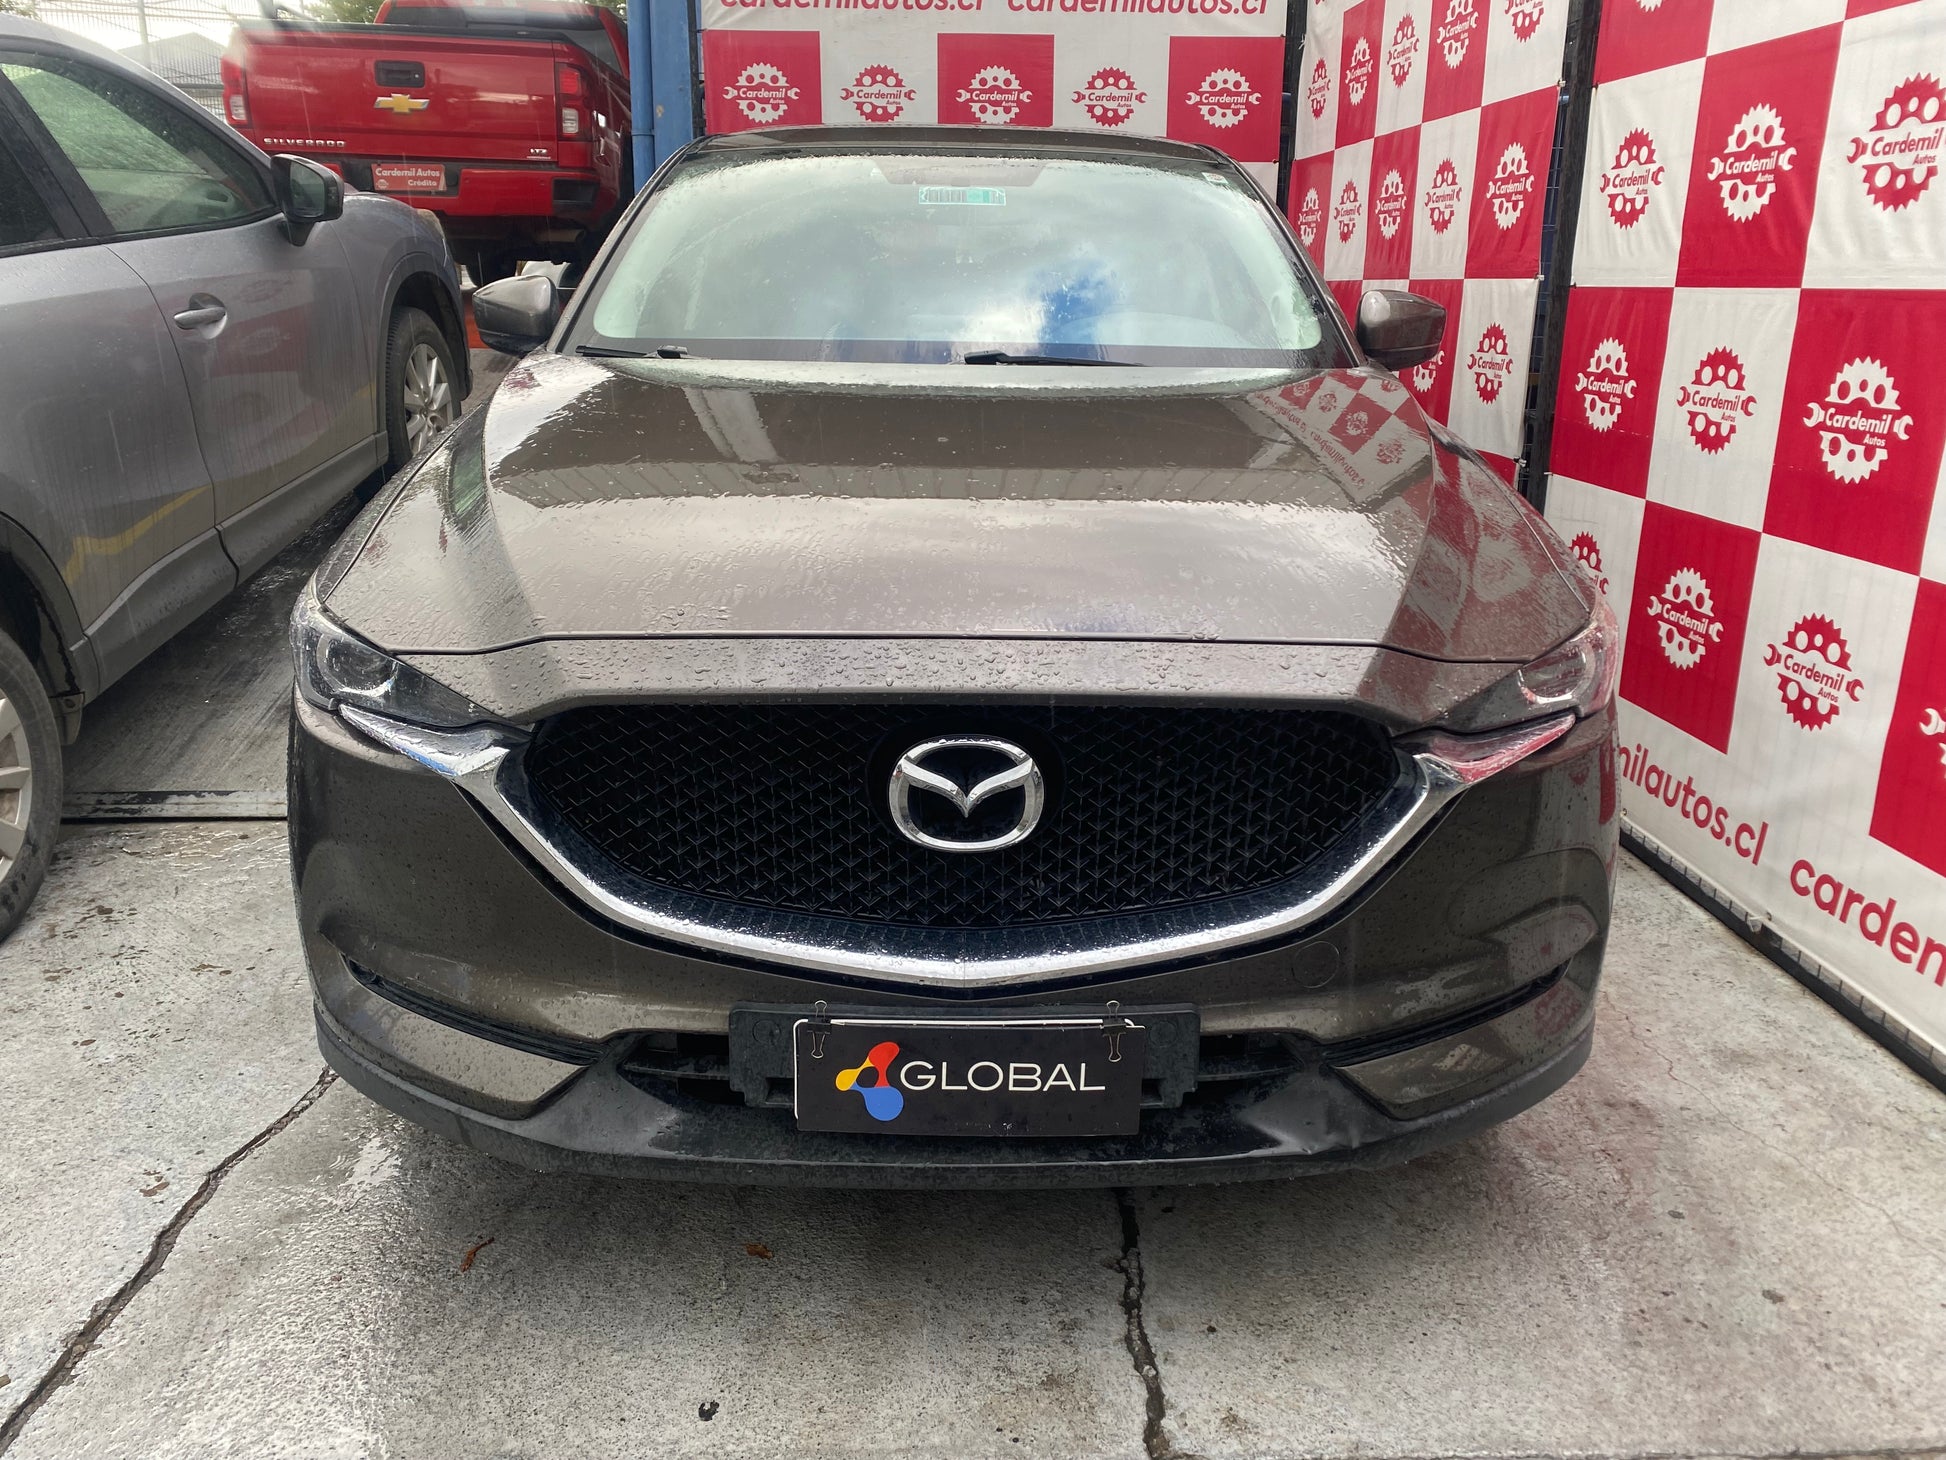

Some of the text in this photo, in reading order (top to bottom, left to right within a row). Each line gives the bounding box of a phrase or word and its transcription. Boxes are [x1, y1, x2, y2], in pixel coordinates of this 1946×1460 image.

[739, 88, 785, 98] Cardemil
[856, 89, 902, 99] Cardemil
[972, 91, 1018, 101] Cardemil
[1088, 92, 1133, 102] Cardemil
[1202, 93, 1247, 103] Cardemil
[263, 137, 346, 148] SILVERADO
[1871, 127, 1945, 156] Cardemil
[1726, 150, 1779, 175] Cardemil
[1912, 153, 1937, 165] Autos
[1611, 168, 1651, 188] Cardemil
[1588, 375, 1625, 394] Cardemil
[1691, 390, 1741, 412] Cardemil
[1825, 407, 1893, 434] Cardemil
[1863, 433, 1886, 447] Autos
[1663, 603, 1709, 635] Cardemil
[1784, 653, 1845, 692] Cardemil
[1817, 686, 1840, 703] Autos
[900, 1061, 1106, 1093] GLOBAL
